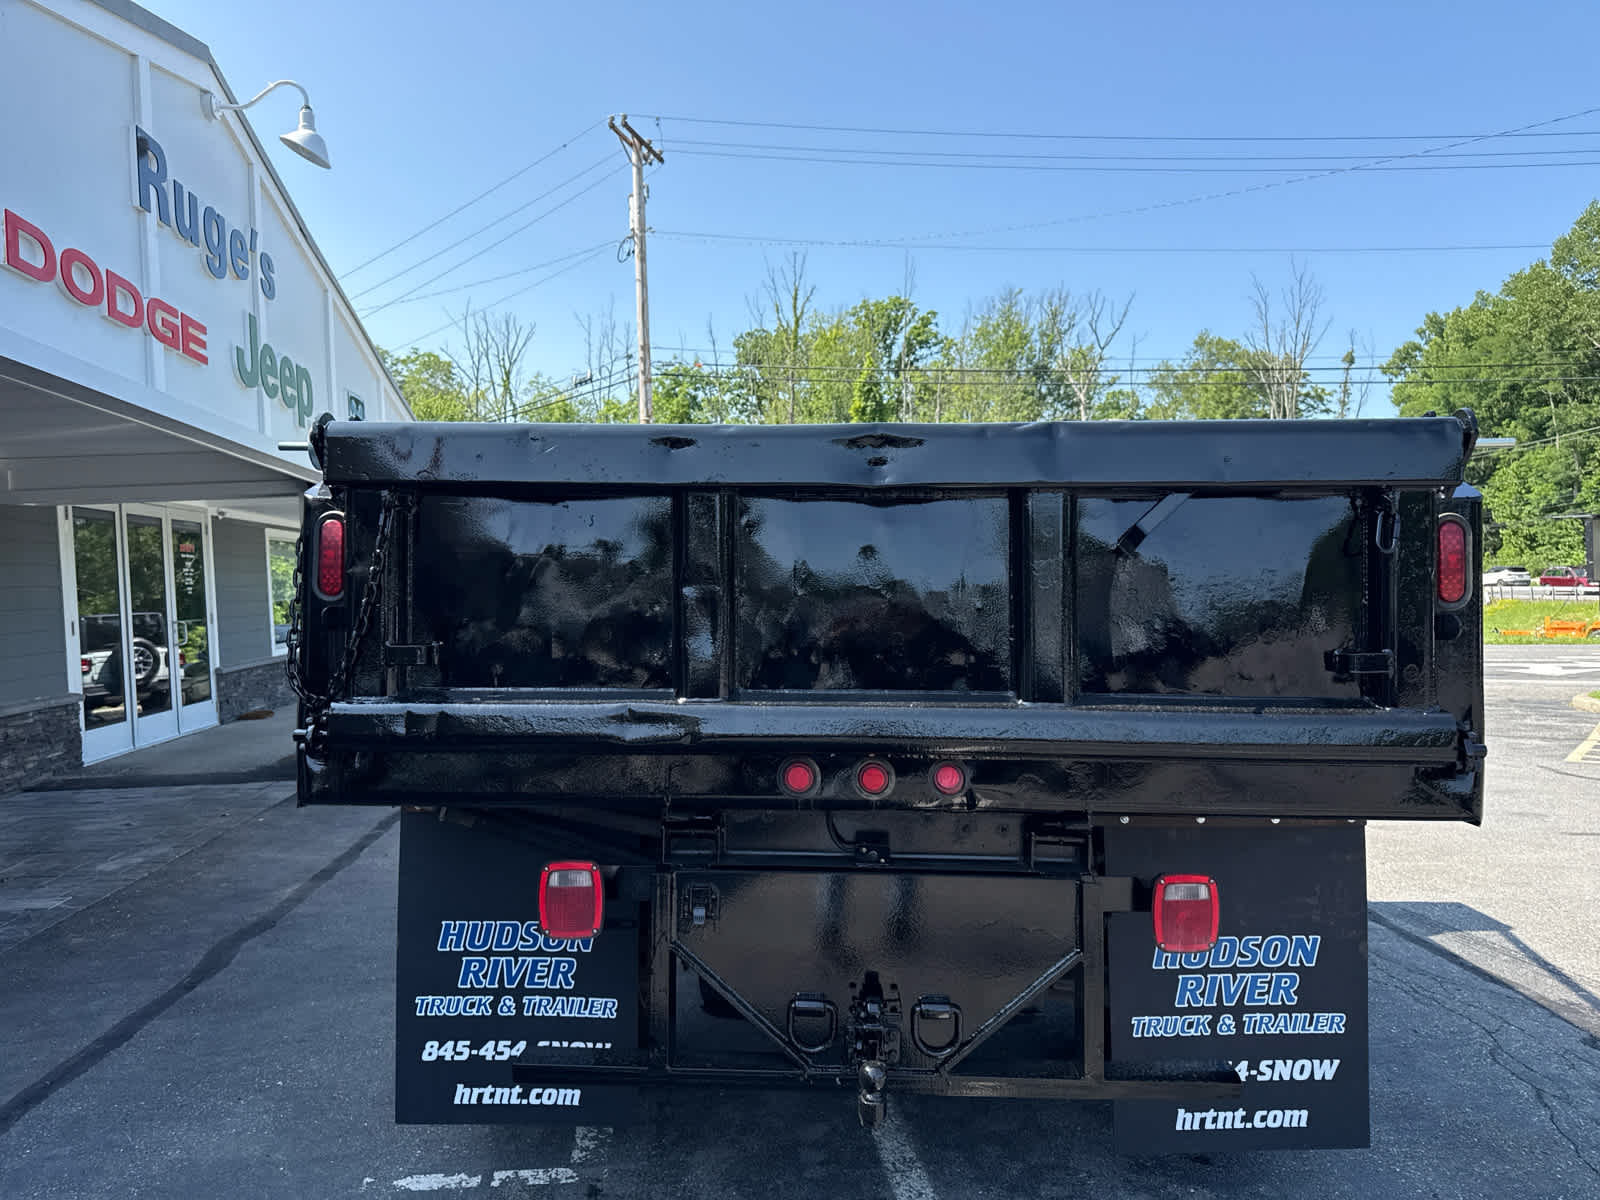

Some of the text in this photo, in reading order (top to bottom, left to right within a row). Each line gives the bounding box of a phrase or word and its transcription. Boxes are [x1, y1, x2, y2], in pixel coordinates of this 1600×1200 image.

[135, 125, 276, 301] Ruge's
[4, 208, 209, 365] DODGE
[235, 312, 314, 429] Jeep
[457, 956, 577, 989] RIVER
[415, 994, 619, 1019] TRUCK & TRAILER
[1174, 972, 1301, 1008] RIVER
[1131, 1012, 1347, 1038] TRUCK & TRAILER
[453, 1083, 582, 1106] hrtnt.com
[1175, 1107, 1309, 1131] hrtnt.com
